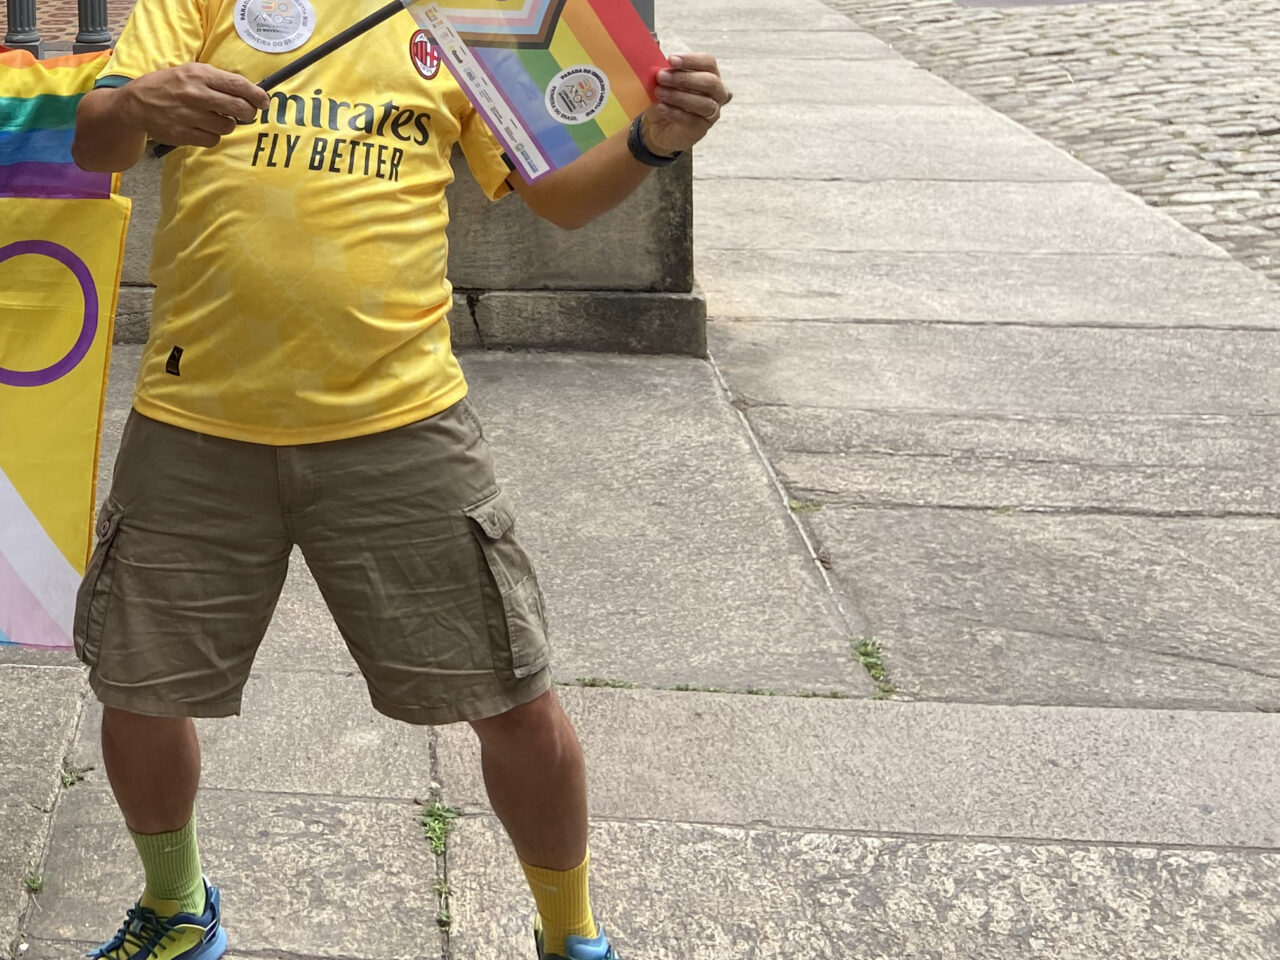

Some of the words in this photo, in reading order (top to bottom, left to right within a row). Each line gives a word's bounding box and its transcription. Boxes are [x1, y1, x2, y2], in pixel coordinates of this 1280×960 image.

[261, 0, 293, 14] 30
[244, 29, 271, 47] PRIMEIRA
[283, 32, 304, 46] BRASIL
[236, 88, 432, 146] mirates
[251, 132, 300, 169] FLY
[308, 137, 404, 182] BETTER
